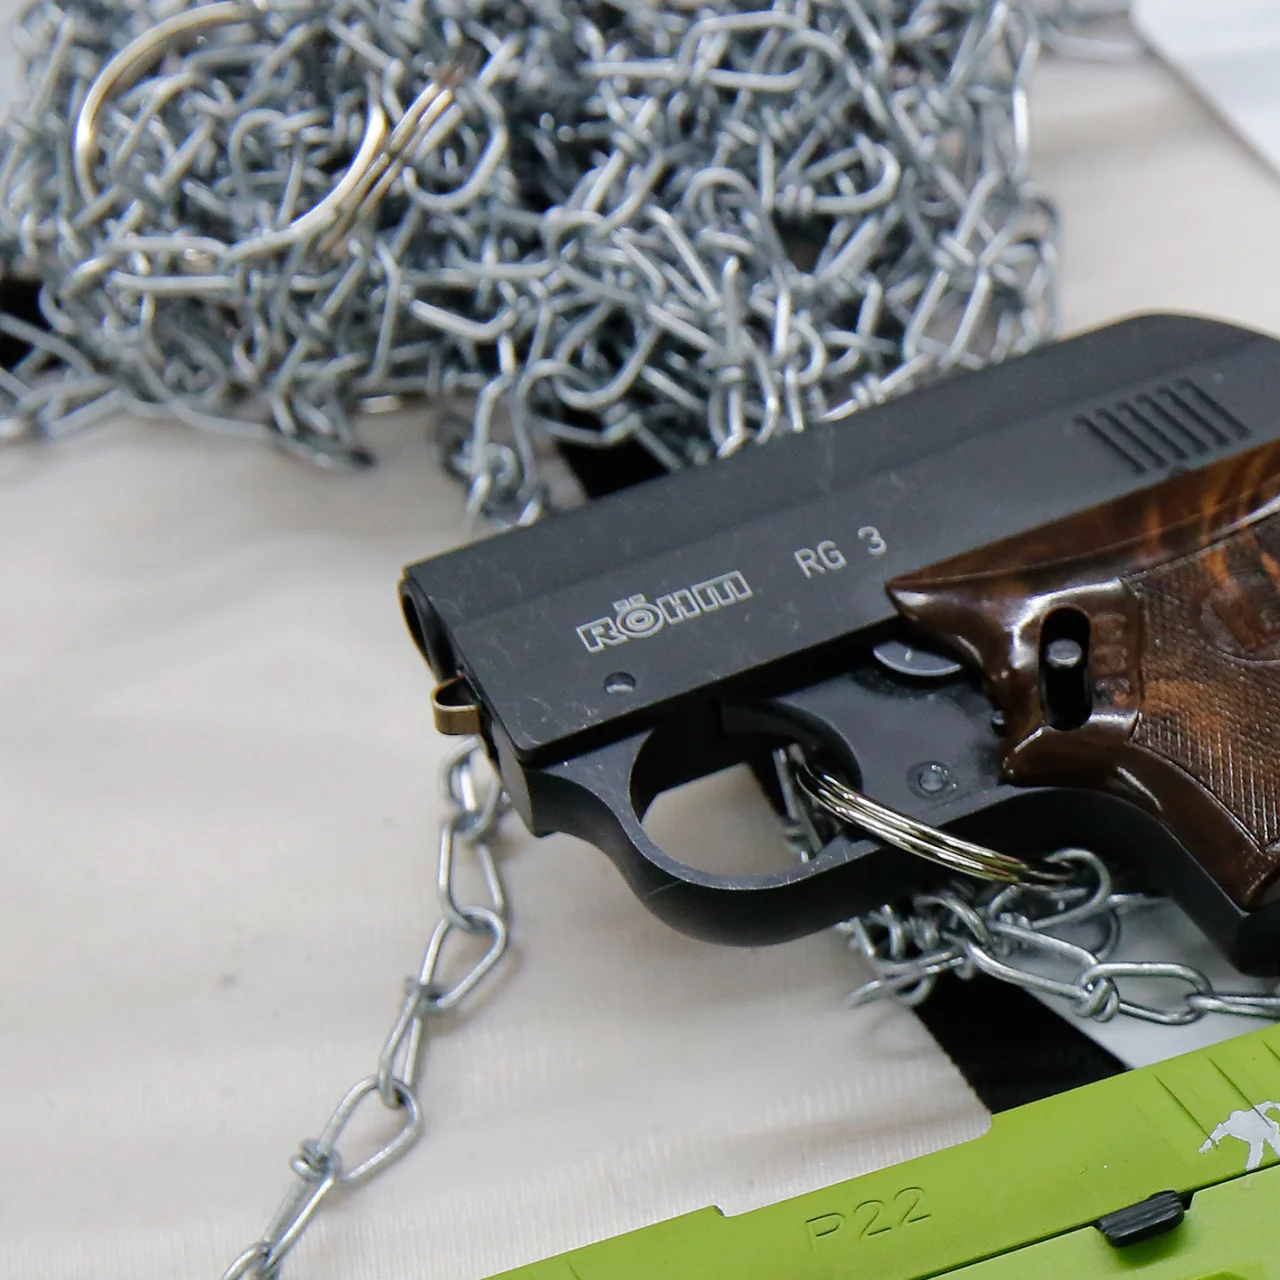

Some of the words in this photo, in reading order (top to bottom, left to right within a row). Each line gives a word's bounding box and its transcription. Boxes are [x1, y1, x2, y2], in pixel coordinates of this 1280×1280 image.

[794, 539, 847, 580] RG
[857, 525, 887, 556] 3
[805, 1186, 932, 1250] P22
